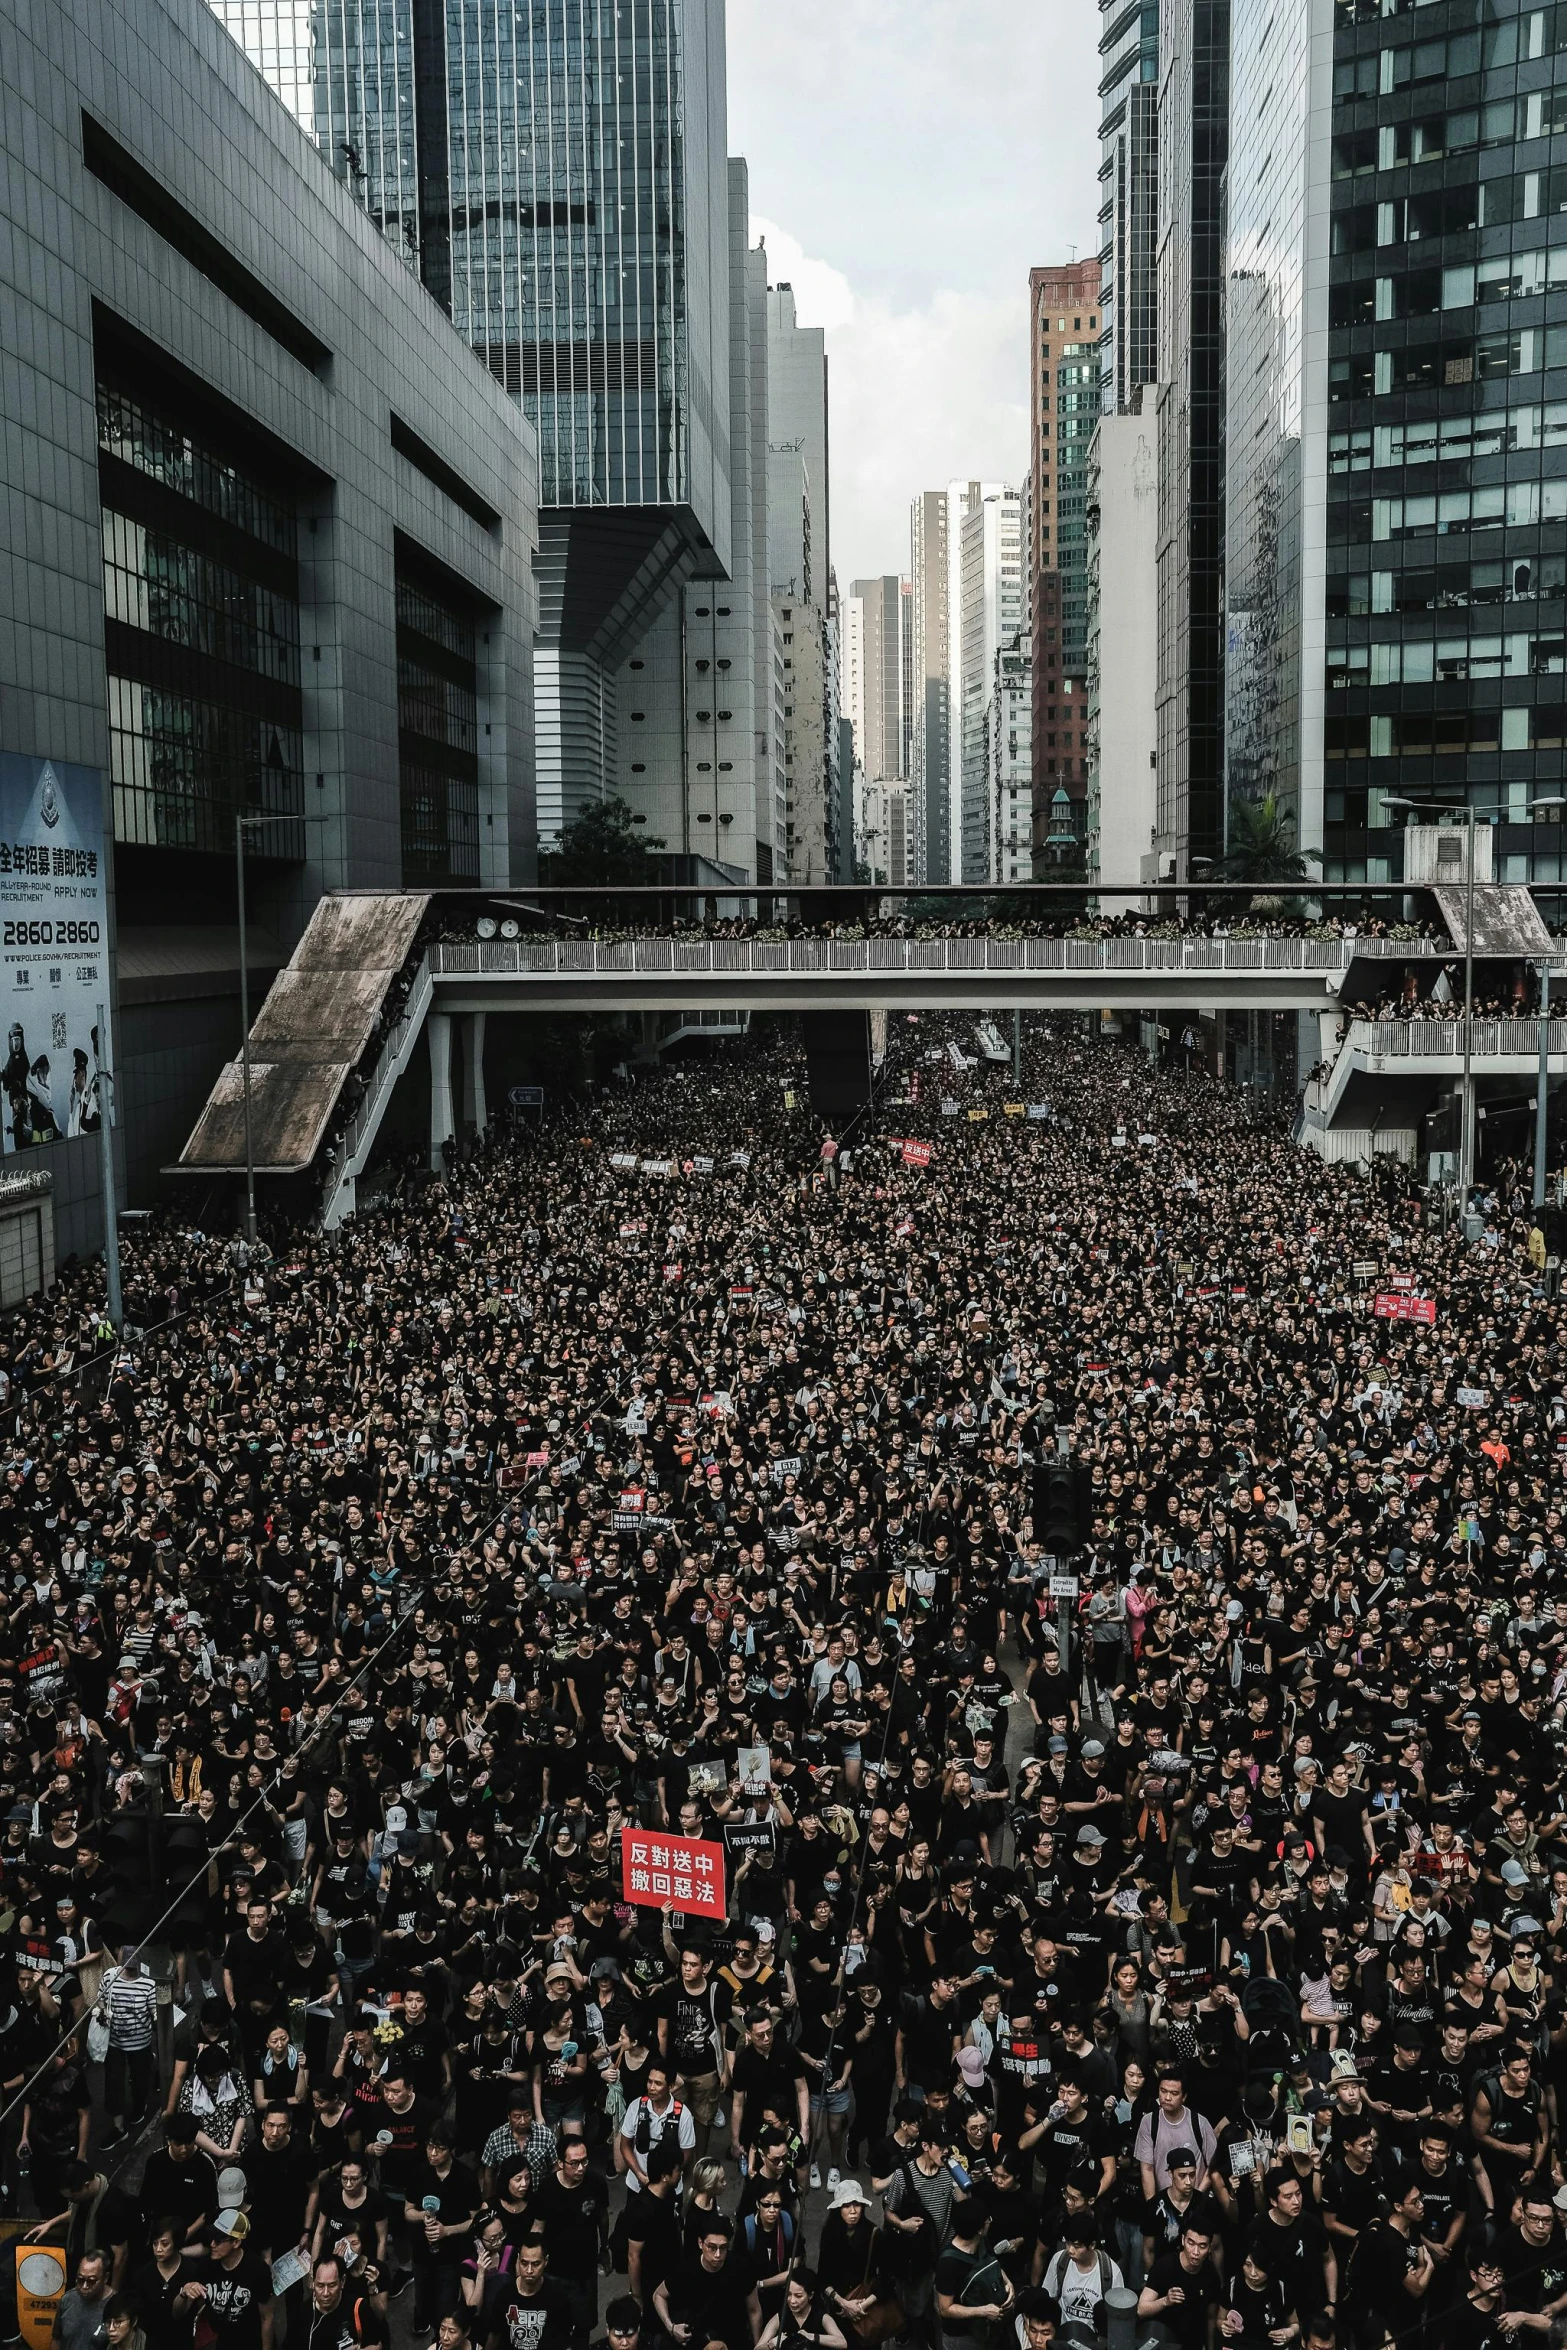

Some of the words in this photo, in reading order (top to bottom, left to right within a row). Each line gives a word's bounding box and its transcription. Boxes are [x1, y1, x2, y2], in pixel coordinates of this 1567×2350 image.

[1, 842, 51, 875] 全年招募
[52, 847, 98, 878] 請即投考
[1, 880, 52, 894] ALL-YEAR-ROUND
[54, 886, 77, 900] APPLY
[80, 888, 98, 899] NOW
[1, 893, 44, 903] RECRUITMENT
[4, 921, 53, 946] 2860
[55, 921, 101, 945] 2860
[905, 1142, 931, 1158] 反送中
[782, 1461, 797, 1470] 612
[29, 1661, 60, 1679] 逃犯條例
[347, 1716, 374, 1727] FREEDOM
[630, 1842, 714, 1876] 反對送中
[630, 1868, 716, 1905] 撤回惡法
[27, 1941, 51, 1958] 學生
[15, 1951, 64, 1973] 沒有暴動
[1396, 2003, 1434, 2023] Hamilton
[1012, 2043, 1038, 2059] 學生
[1002, 2057, 1051, 2076] 沒有暴動
[30, 2301, 58, 2310] 47293
